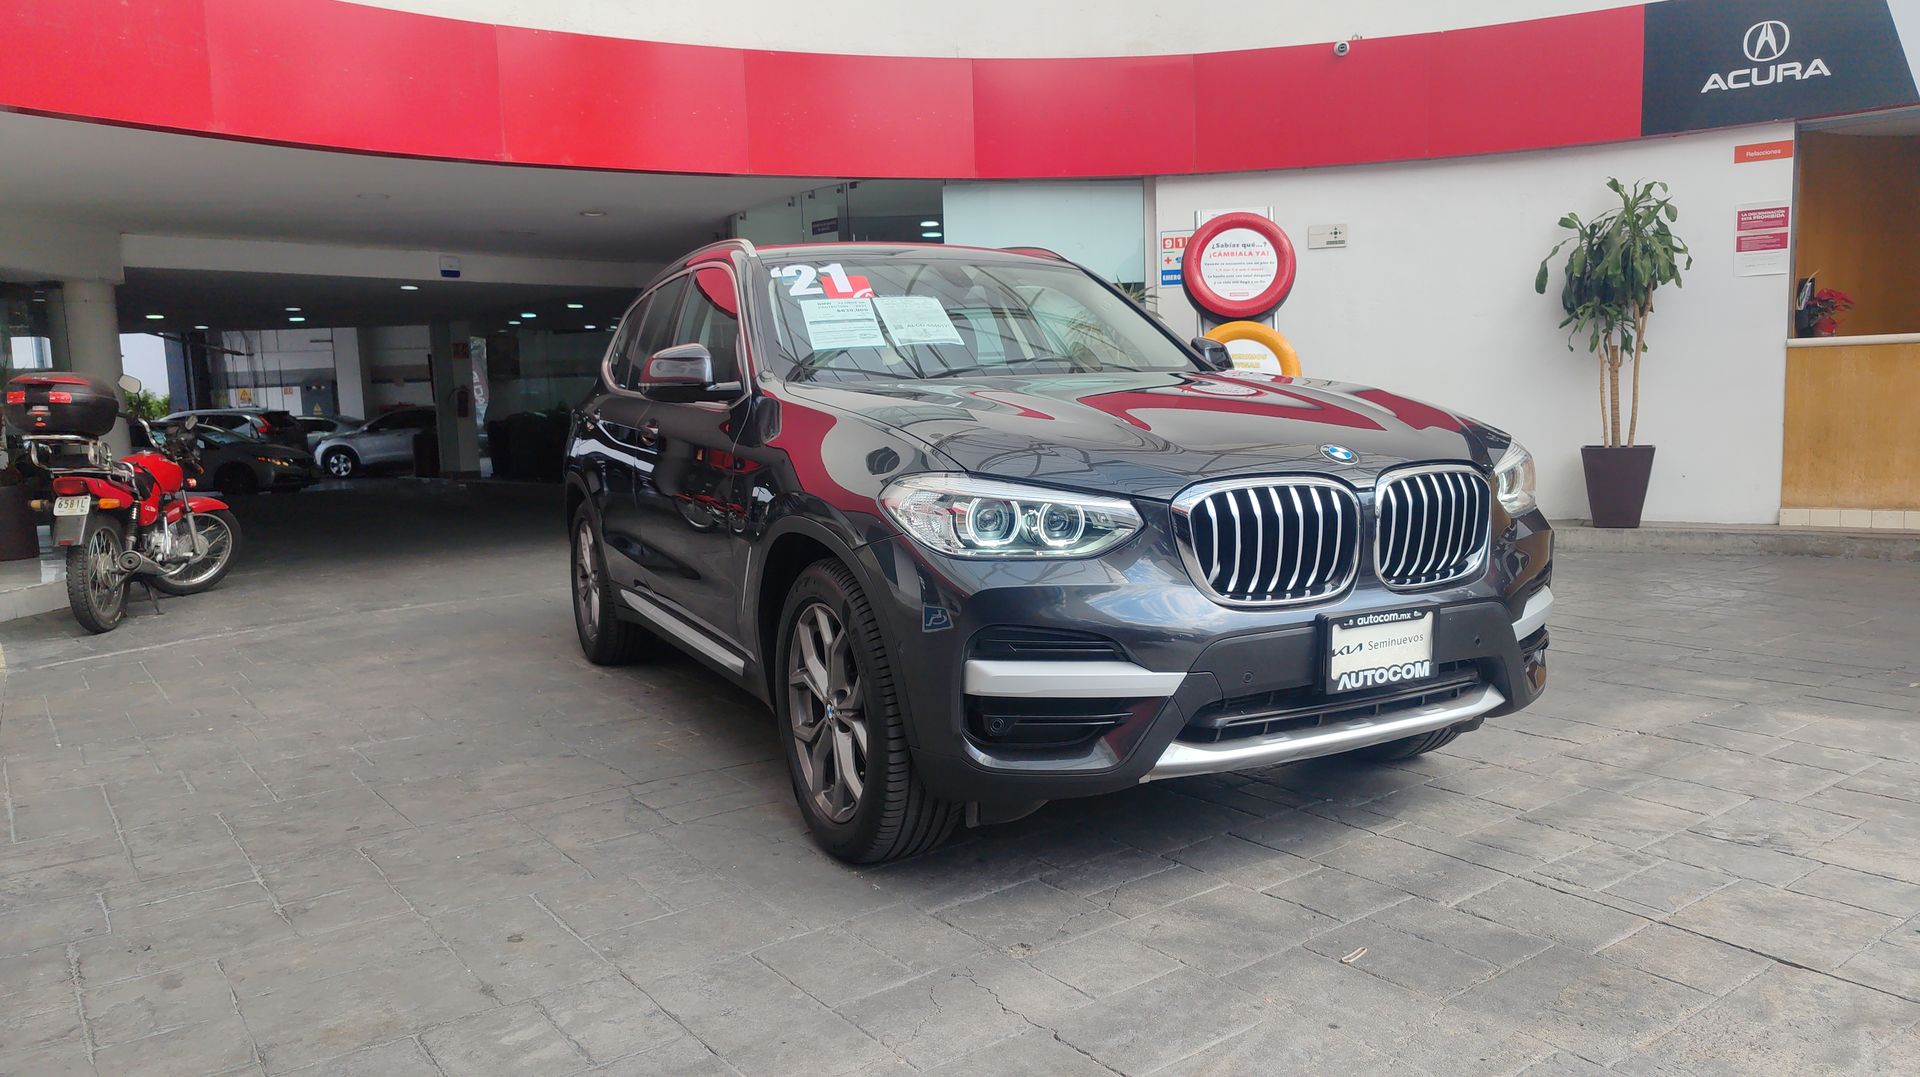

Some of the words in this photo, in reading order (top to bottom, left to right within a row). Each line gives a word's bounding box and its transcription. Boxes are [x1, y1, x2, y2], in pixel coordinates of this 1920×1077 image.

[1700, 58, 1832, 94] ACURA
[1357, 611, 1412, 626] autocom.mx
[1367, 633, 1424, 651] Seminuevos
[1337, 660, 1430, 691] AUTOCOM
